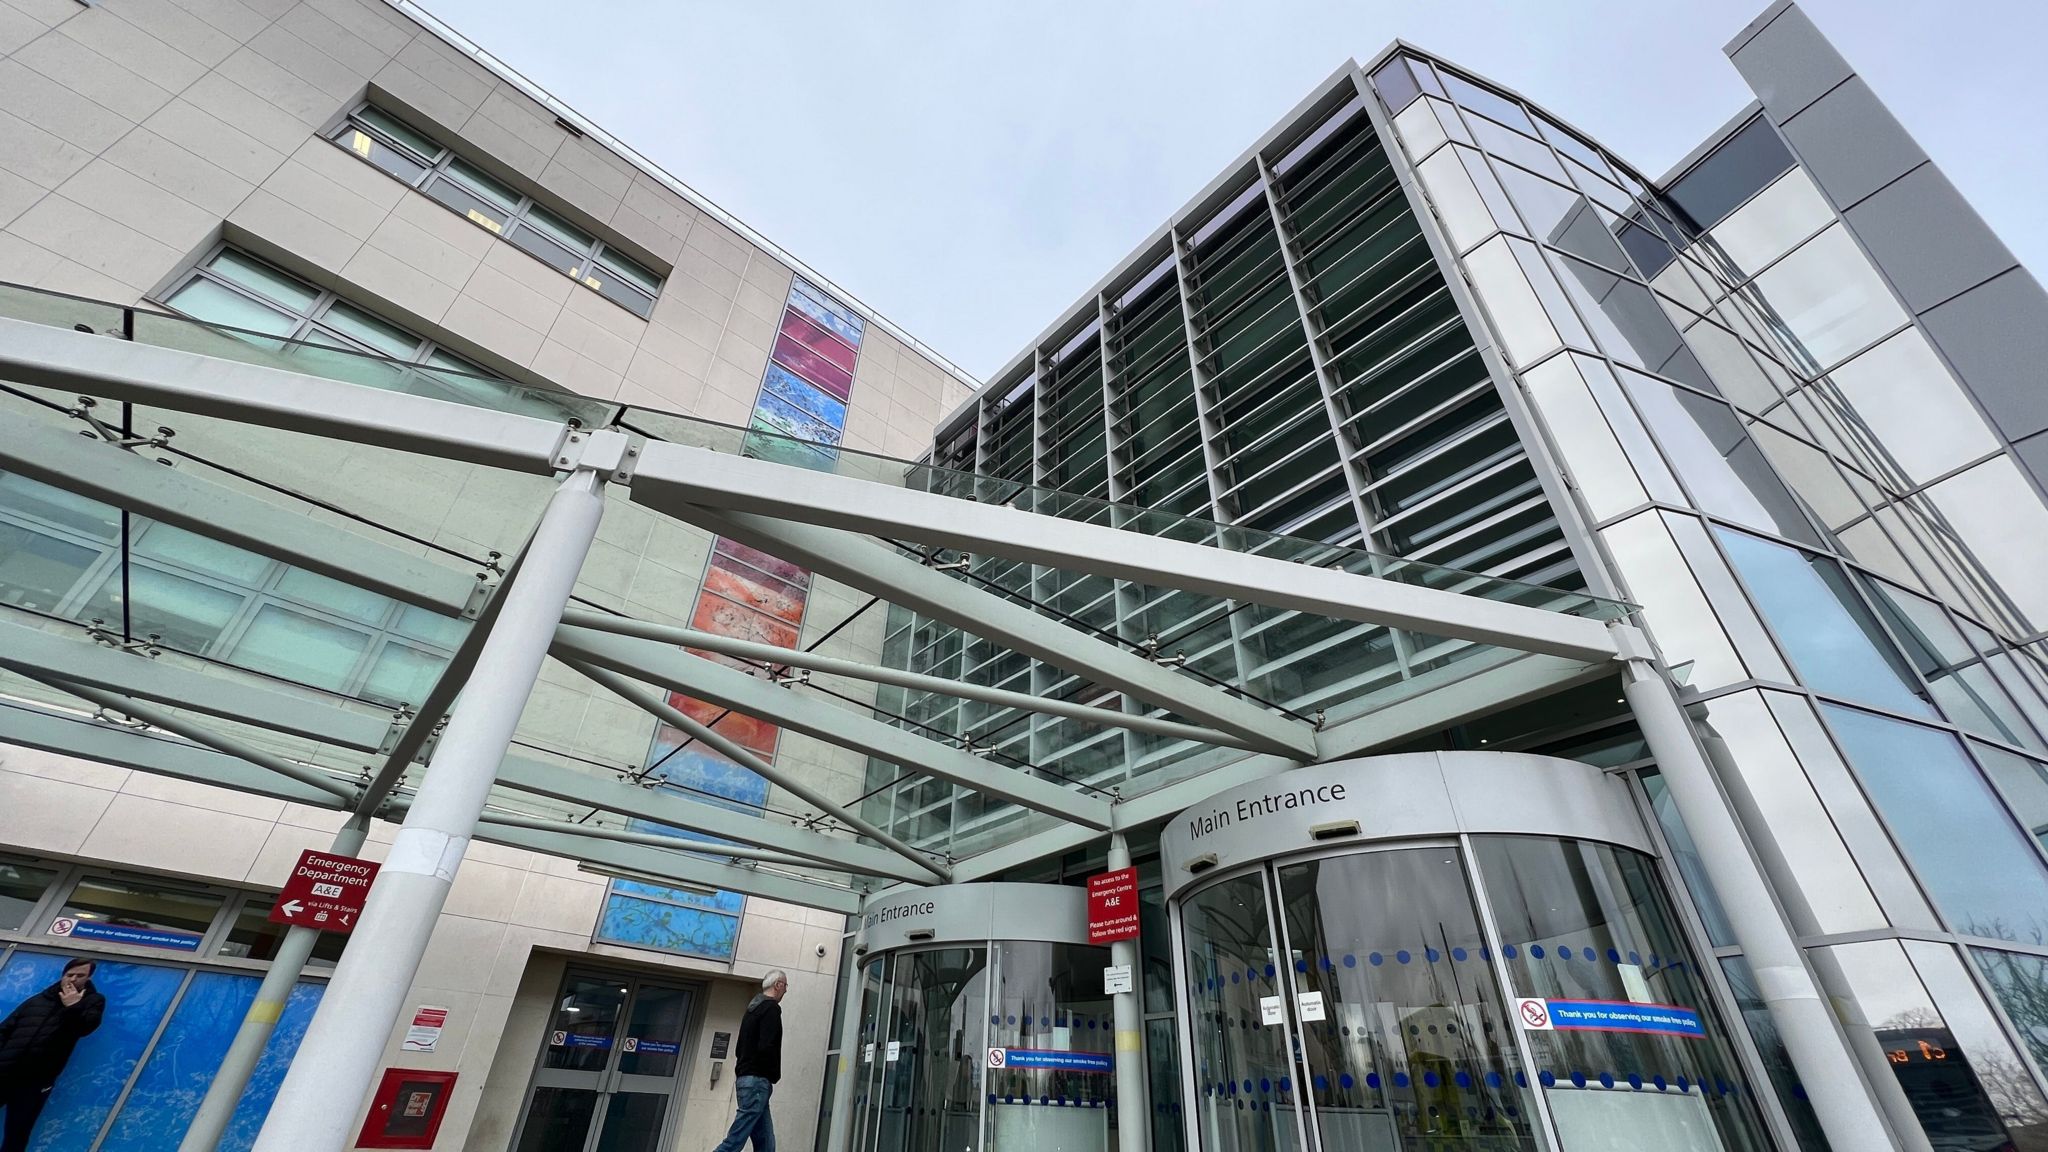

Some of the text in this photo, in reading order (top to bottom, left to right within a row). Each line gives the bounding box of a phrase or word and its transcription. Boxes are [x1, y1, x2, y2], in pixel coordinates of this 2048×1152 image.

[1190, 783, 1346, 840] Main Entrance
[306, 855, 370, 876] Emergency
[297, 866, 368, 886] Department
[314, 885, 340, 896] A&E
[1092, 888, 1116, 898] Emergency
[1105, 897, 1120, 907] A&E
[340, 905, 358, 914] Stairs
[881, 901, 934, 923] Entrance
[1115, 915, 1132, 924] around
[1125, 925, 1137, 933] signs
[1558, 1010, 1582, 1018] Thank
[1597, 1011, 1608, 1019] for
[1609, 1012, 1641, 1022] observing
[1671, 1017, 1682, 1025] free
[1682, 1018, 1696, 1028] policy
